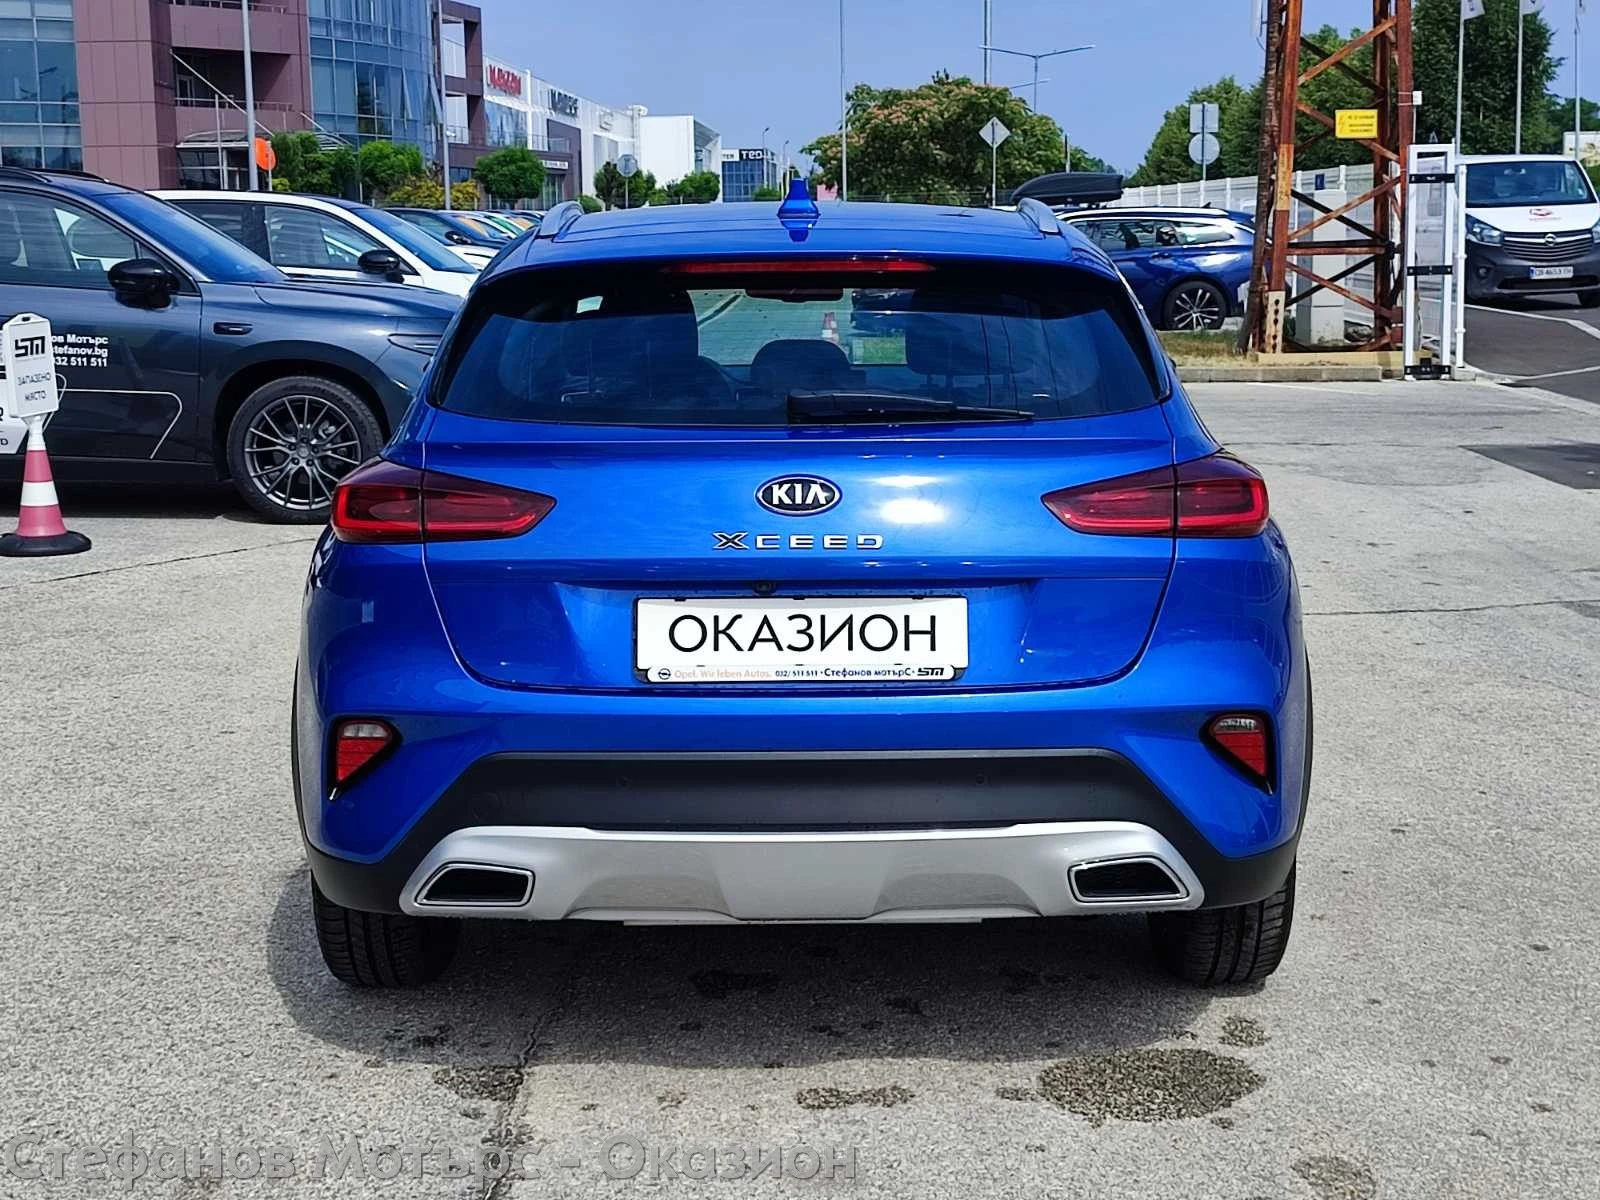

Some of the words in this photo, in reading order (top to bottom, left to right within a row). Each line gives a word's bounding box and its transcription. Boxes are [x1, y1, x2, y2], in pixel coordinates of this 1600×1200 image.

[66, 334, 109, 345] Мотърс
[53, 345, 108, 358] tefanov.bg
[55, 356, 69, 366] 32
[70, 357, 87, 367] 511
[90, 357, 108, 367] 511
[17, 372, 52, 386] ЗАПАЗЕНО
[772, 484, 830, 505] KIA
[712, 532, 884, 551] XCEED
[668, 613, 938, 652] ОКАЗИОН
[717, 669, 742, 678] leben
[793, 669, 804, 677] 511
[806, 669, 818, 677] 511
